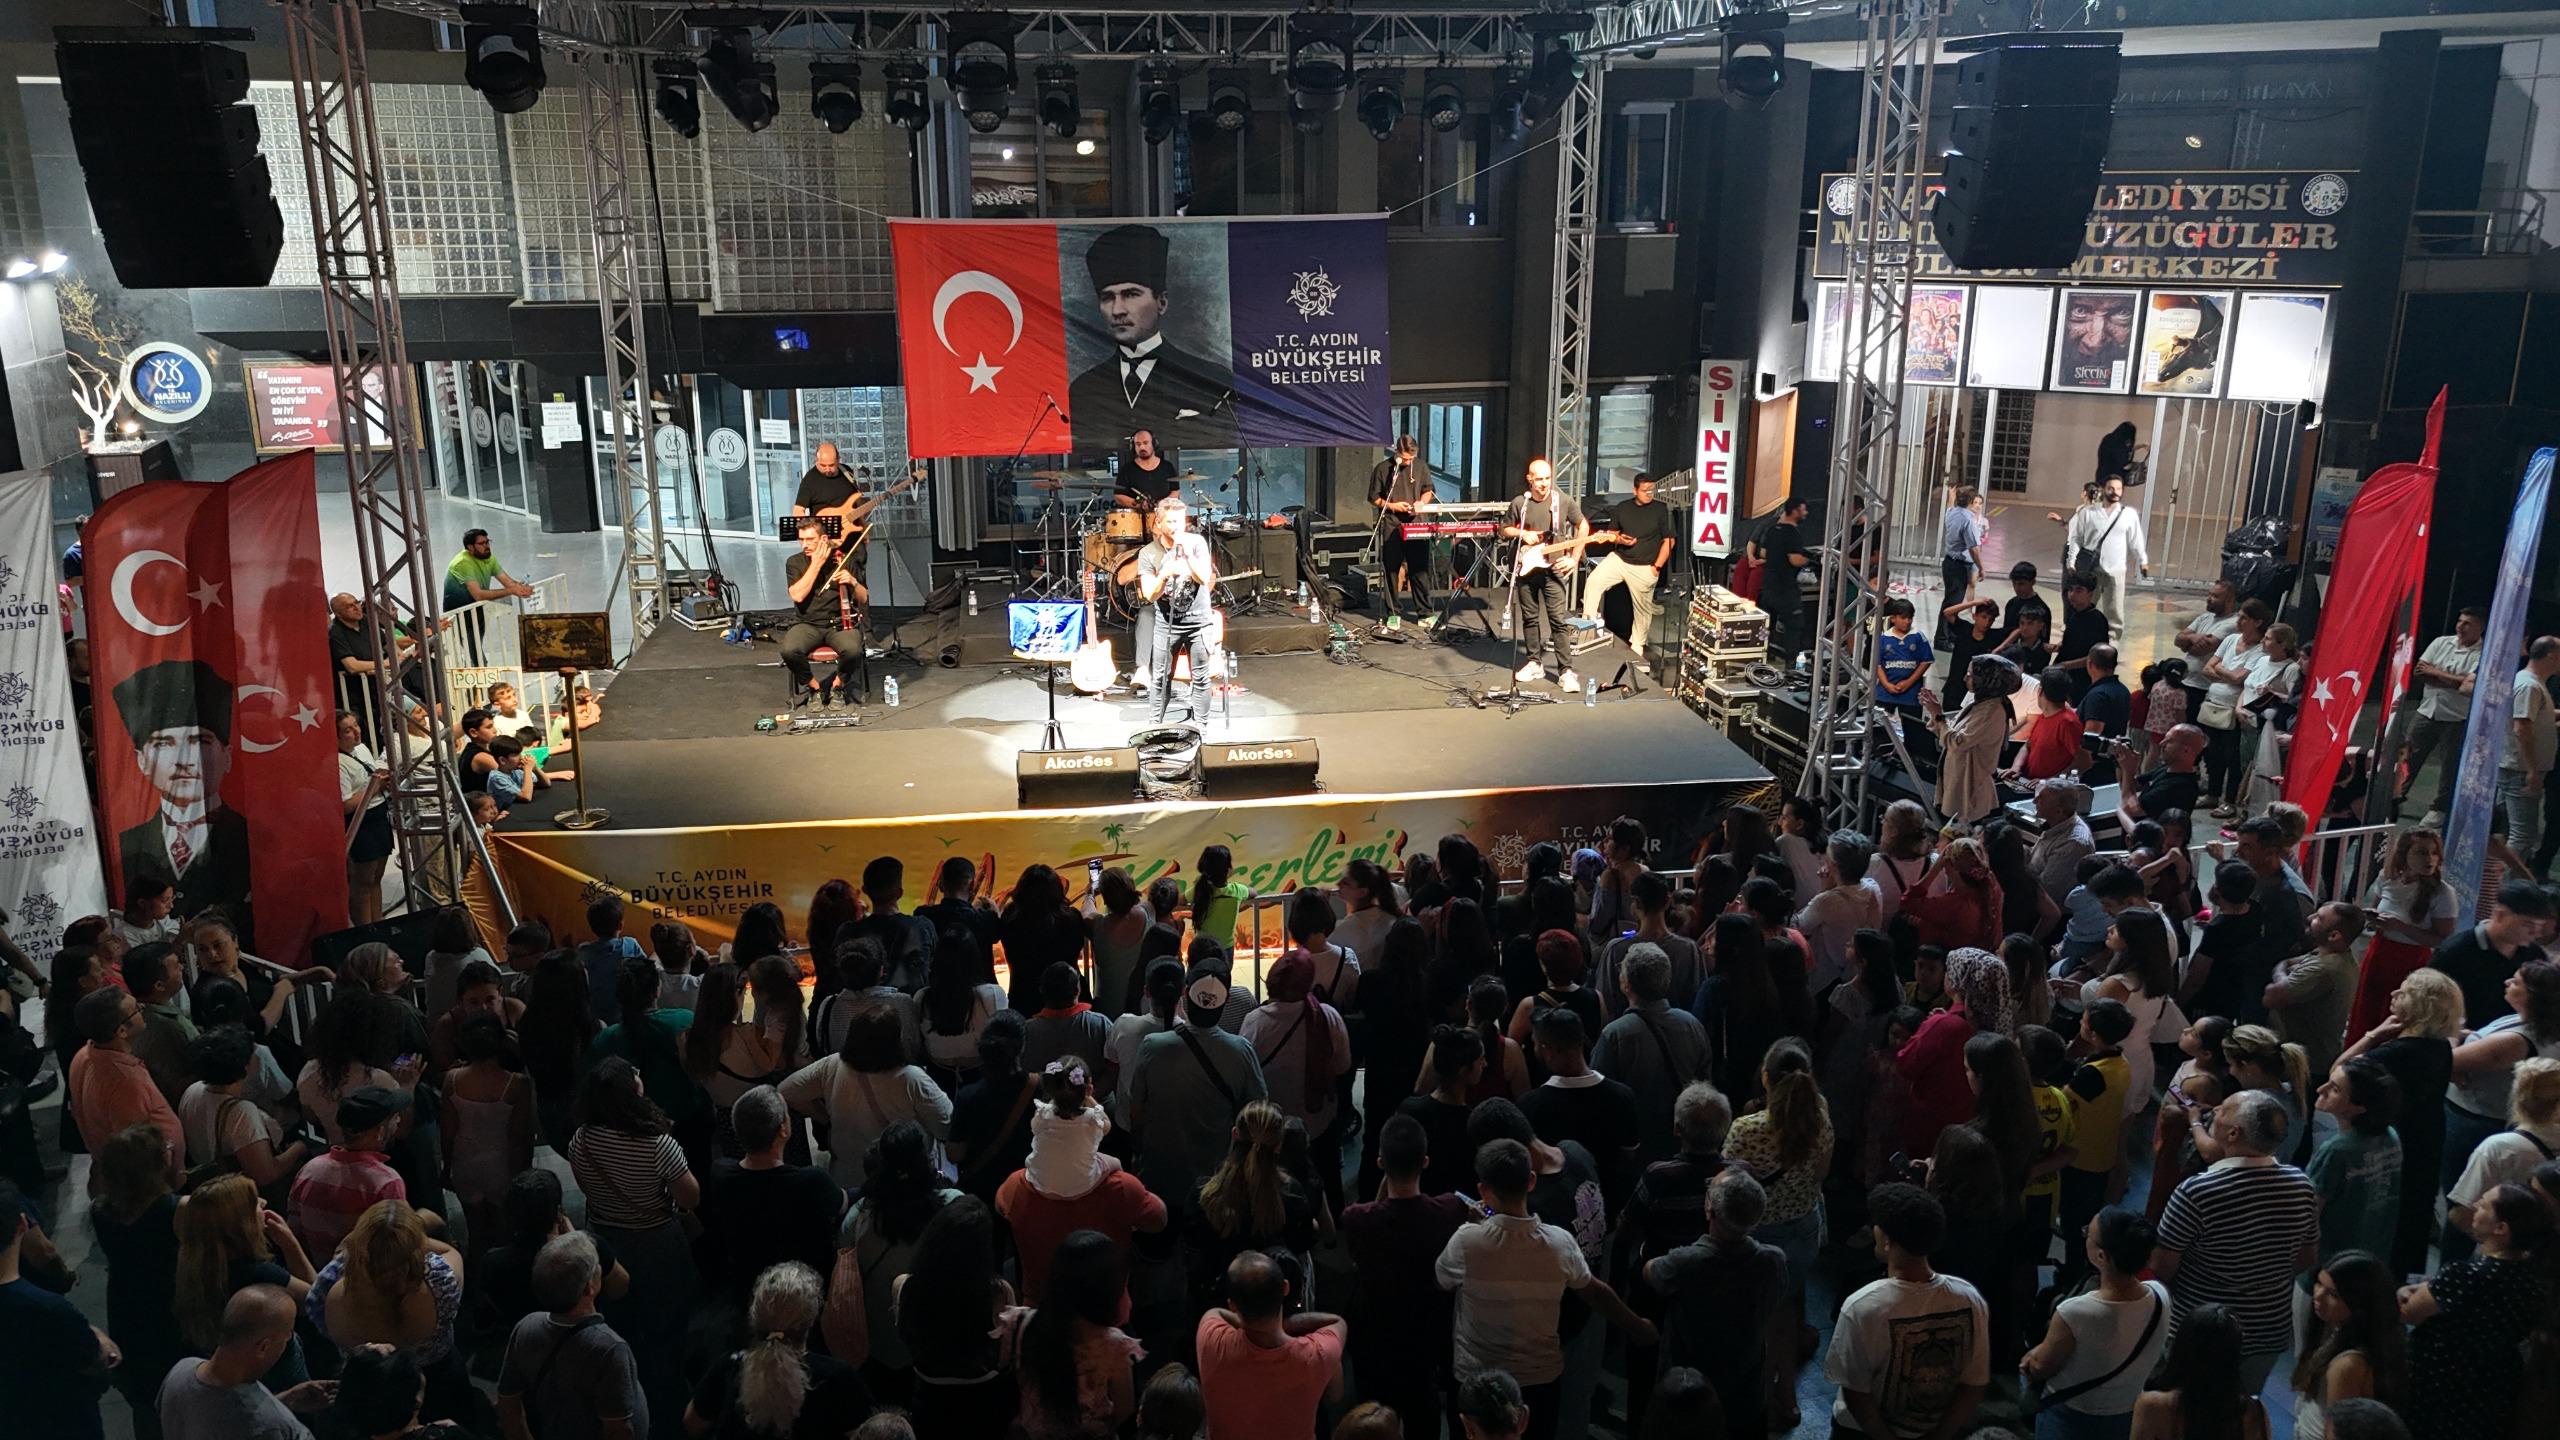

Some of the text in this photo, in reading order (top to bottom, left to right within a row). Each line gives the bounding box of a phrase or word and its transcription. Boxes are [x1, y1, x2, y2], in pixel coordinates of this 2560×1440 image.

[1276, 333, 1358, 347] T.C. AYDIN
[1252, 347, 1382, 369] BÜYÜKŞEHİR
[1271, 367, 1365, 384] BELEDİYESİ
[1698, 366, 1733, 546] SİNEMA
[1044, 755, 1114, 770] AkorSes
[1227, 747, 1295, 762] AkorSes
[656, 868, 746, 883] T.C. AYDIN
[631, 881, 773, 905] BÜYÜKŞEHİR
